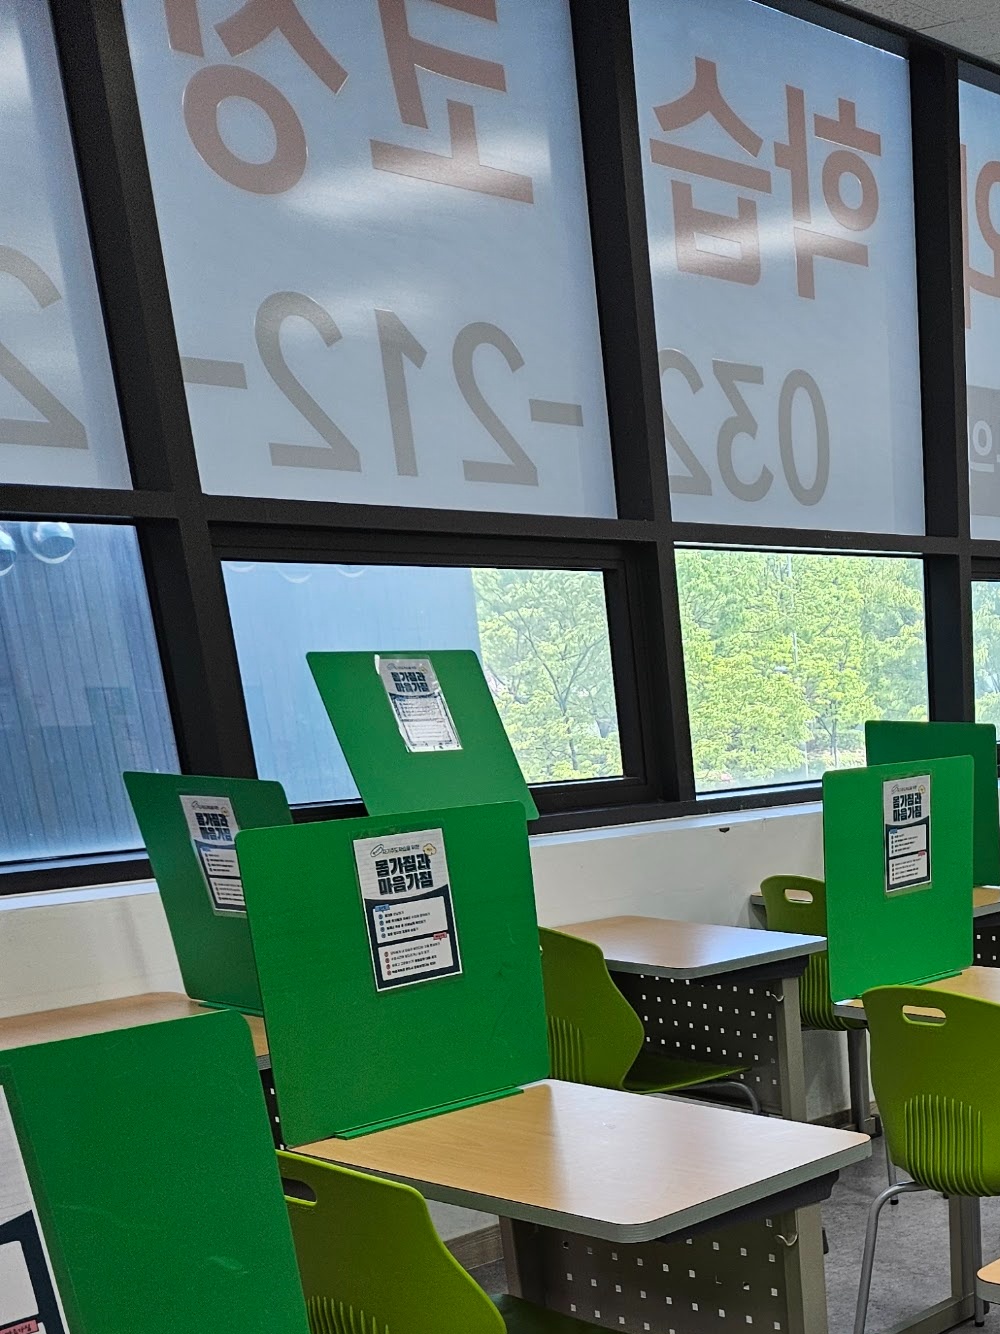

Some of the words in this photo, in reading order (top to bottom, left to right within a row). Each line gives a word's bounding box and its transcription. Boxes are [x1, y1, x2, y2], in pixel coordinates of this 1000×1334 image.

[892, 792, 922, 809] 몸가짐과
[892, 805, 922, 822] 마음가짐
[375, 853, 431, 878] 몸가짐과
[377, 870, 434, 896] 마음가짐
